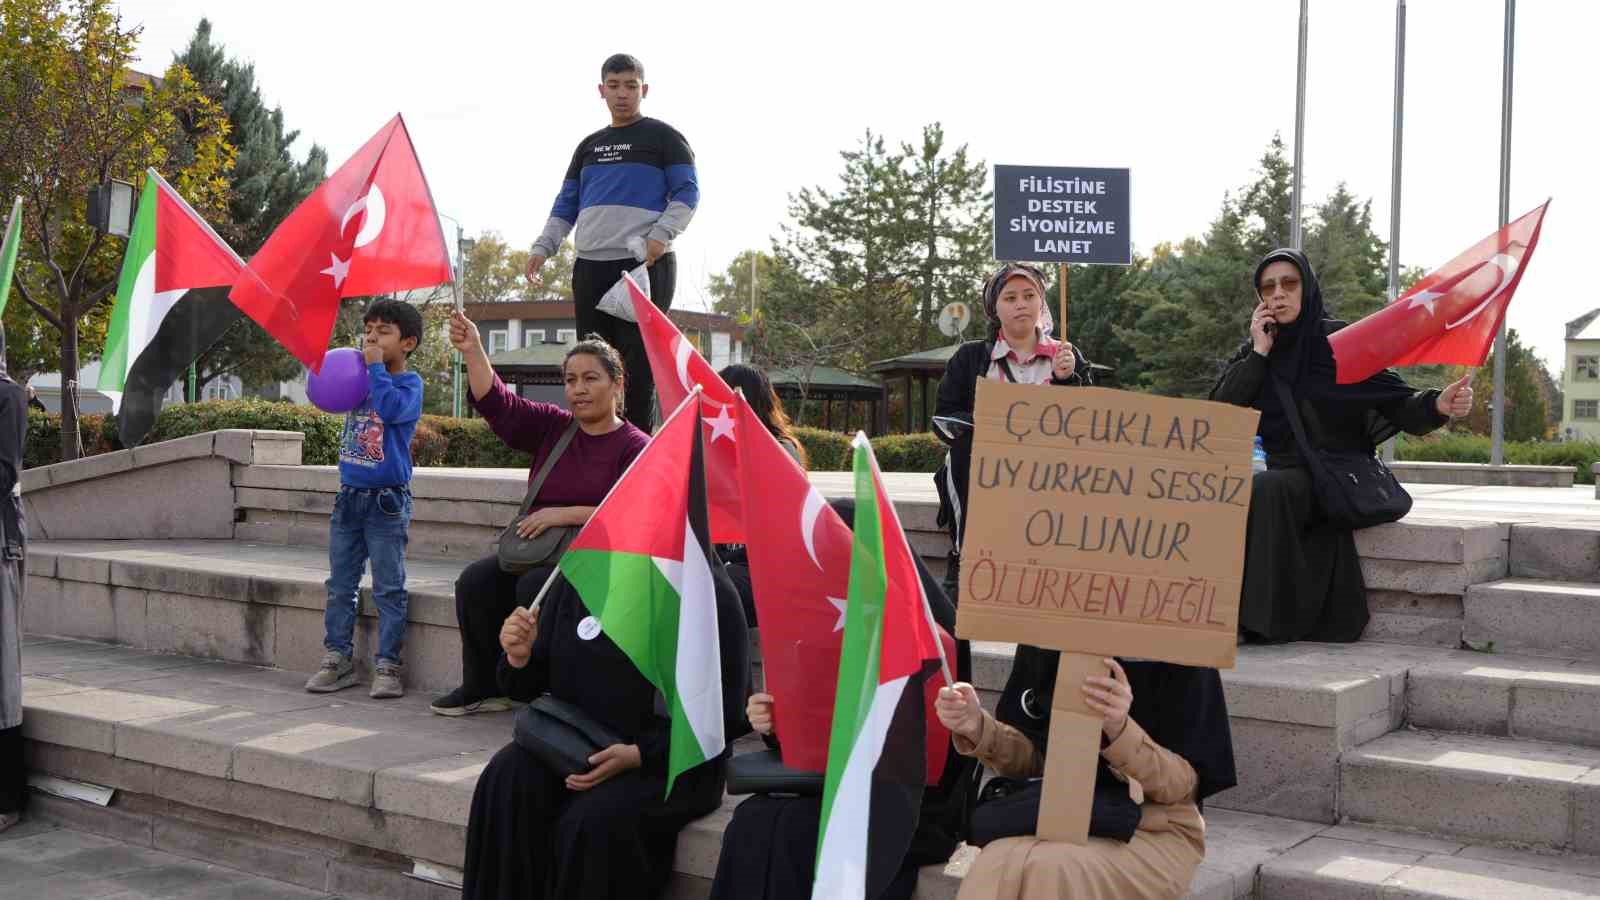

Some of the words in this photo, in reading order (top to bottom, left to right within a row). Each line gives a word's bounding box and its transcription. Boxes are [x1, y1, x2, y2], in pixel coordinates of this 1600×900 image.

[1019, 176, 1106, 195] FİLİSTİNE
[1028, 199, 1097, 214] DESTEK
[1010, 215, 1116, 235] SİYONİZME
[1034, 239, 1092, 254] LANET
[1006, 400, 1214, 455] ÇOÇUKLAR
[977, 456, 1134, 497] UYURKEN
[1147, 463, 1248, 507] SESSİZ
[1025, 509, 1191, 562] OLUNUR
[968, 548, 1131, 616] ÖLÜRKEN
